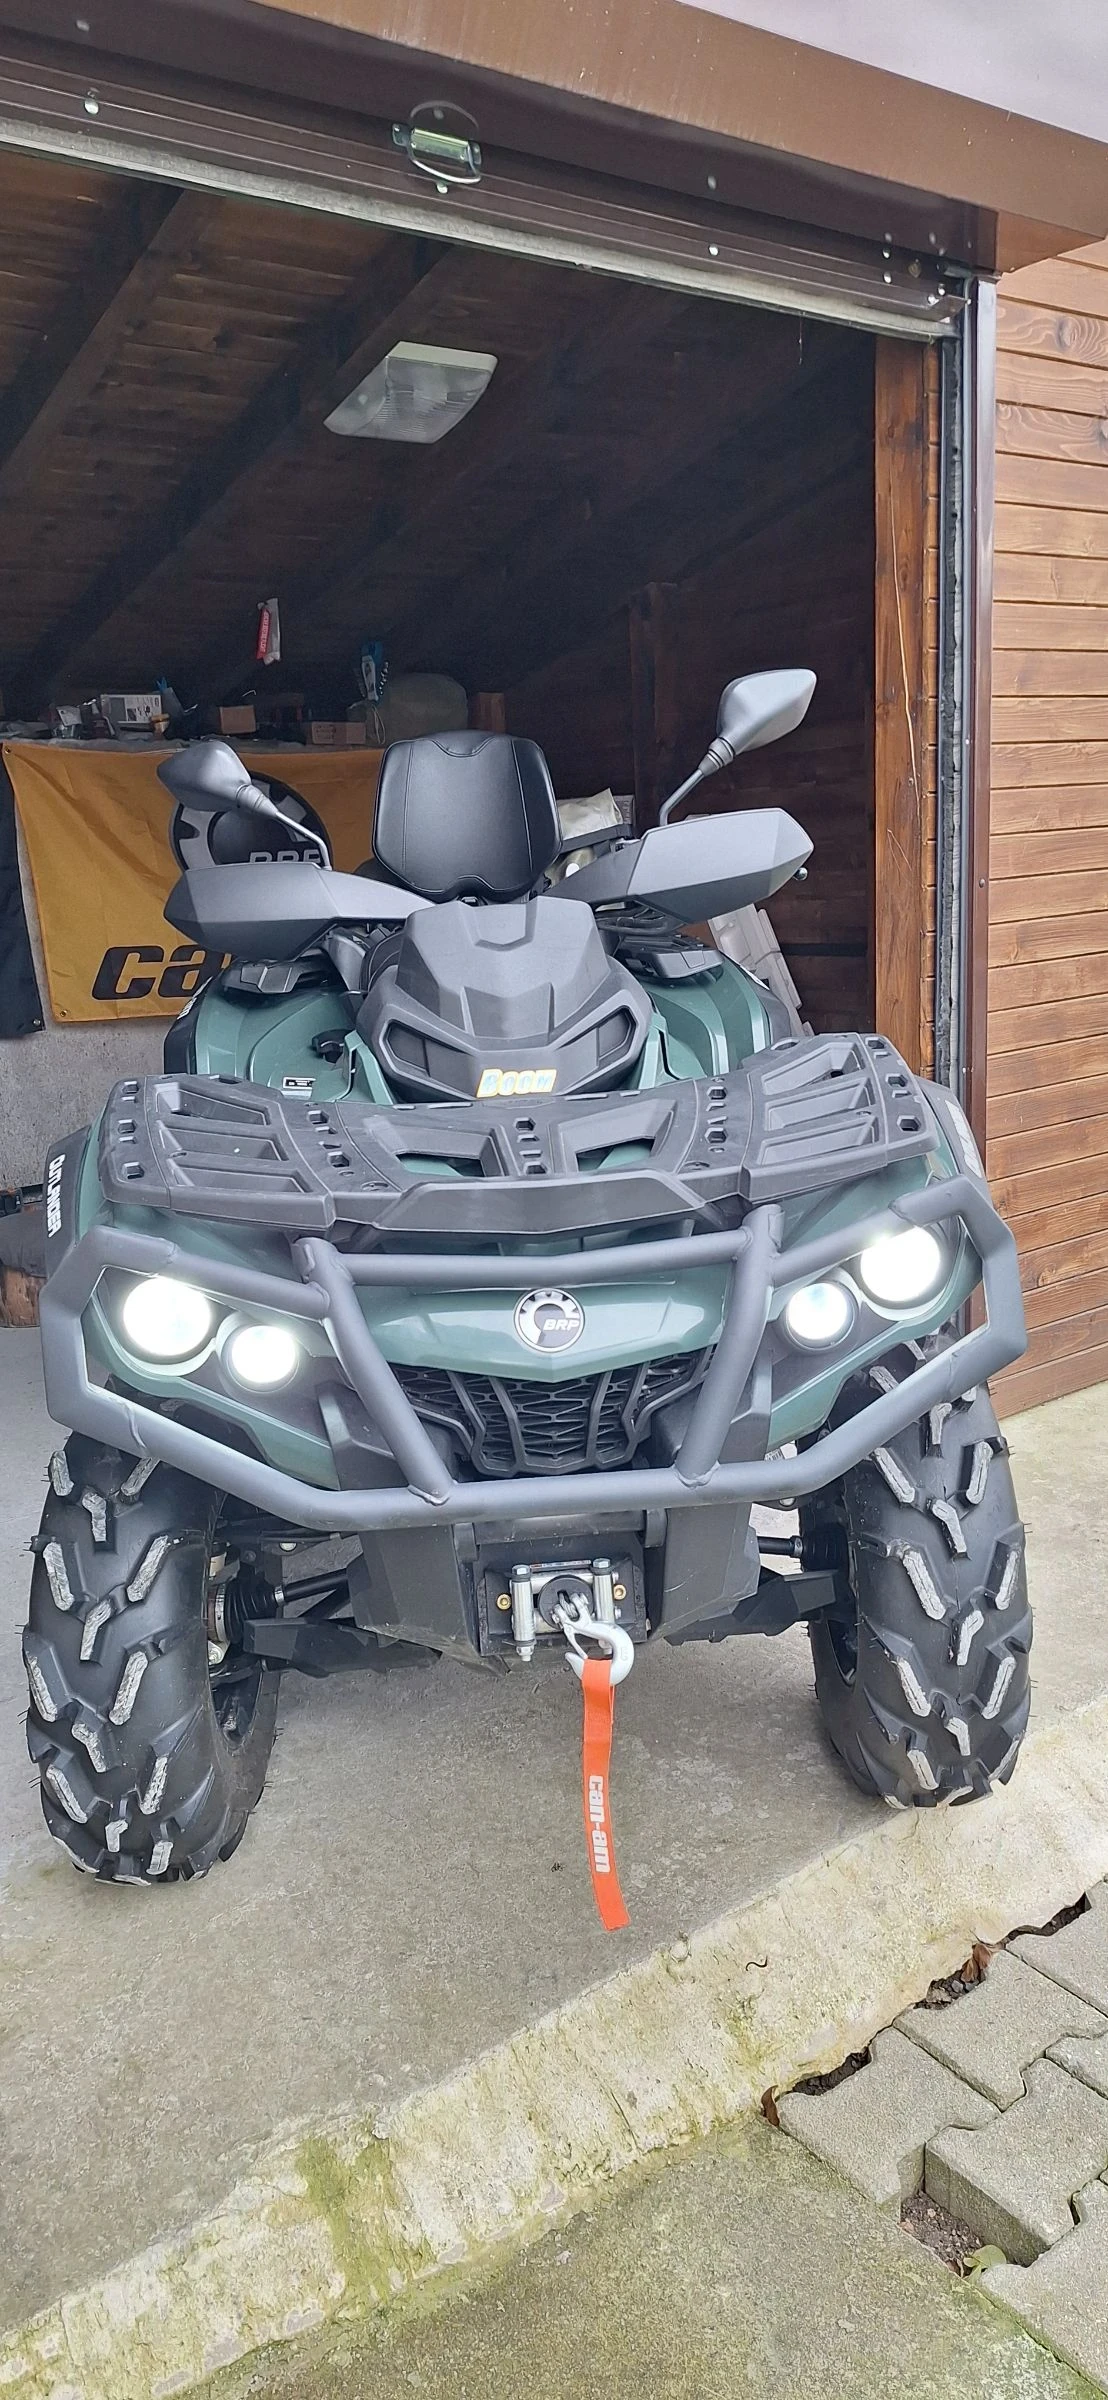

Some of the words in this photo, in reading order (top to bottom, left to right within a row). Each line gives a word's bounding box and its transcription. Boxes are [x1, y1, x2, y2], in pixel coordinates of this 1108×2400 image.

[92, 945, 233, 1000] ca
[477, 1069, 557, 1098] BOOM
[47, 1154, 66, 1238] OUTLANDER
[543, 1318, 580, 1331] BRP
[589, 1775, 611, 1873] can-am
